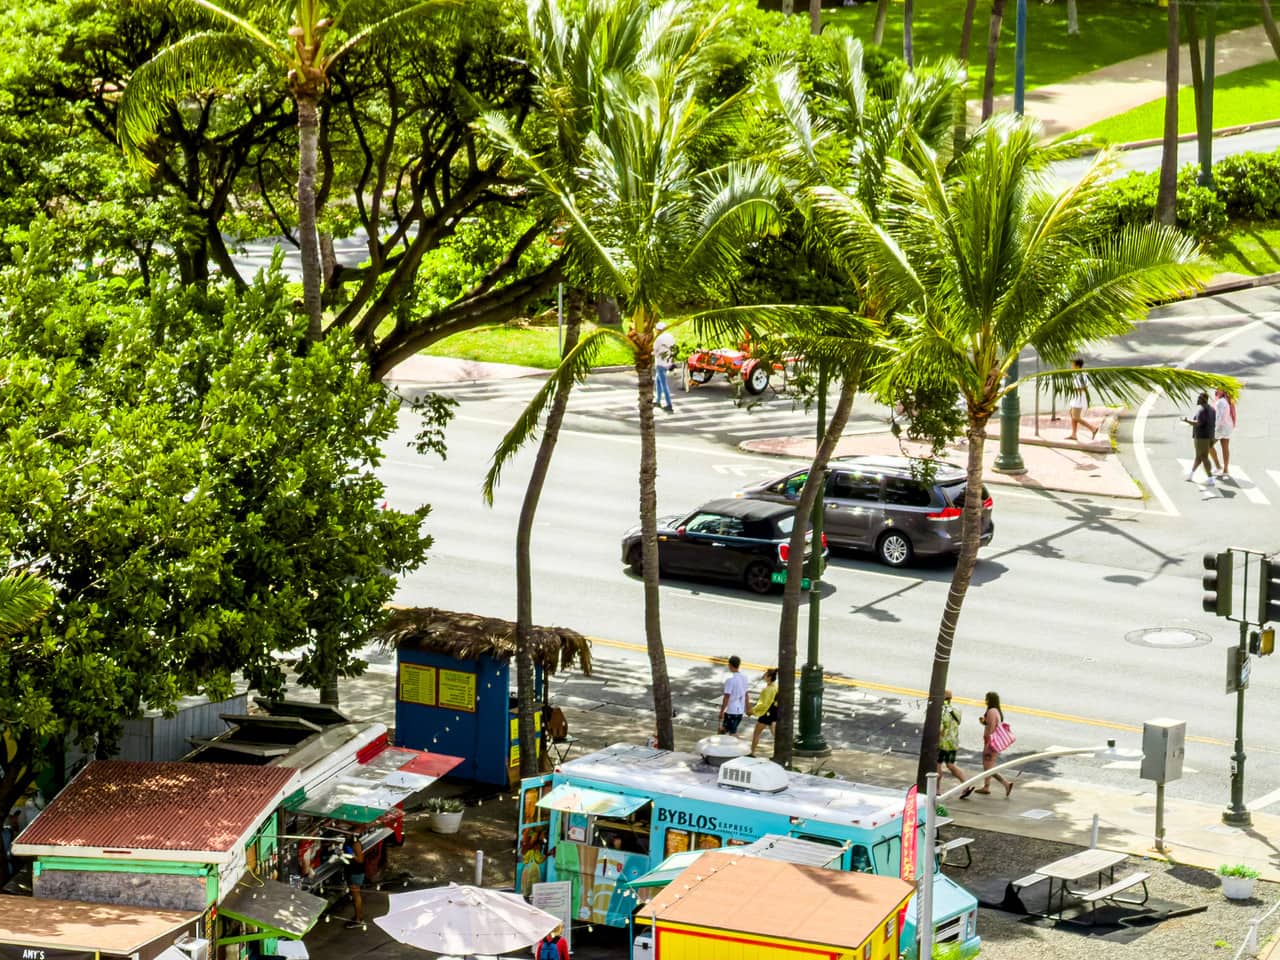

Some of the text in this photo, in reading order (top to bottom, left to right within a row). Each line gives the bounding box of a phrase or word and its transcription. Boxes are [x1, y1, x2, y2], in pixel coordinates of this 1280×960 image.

[658, 807, 718, 831] BYBLOS
[718, 822, 754, 834] EXPRESS
[22, 949, 45, 960] AMY'S
